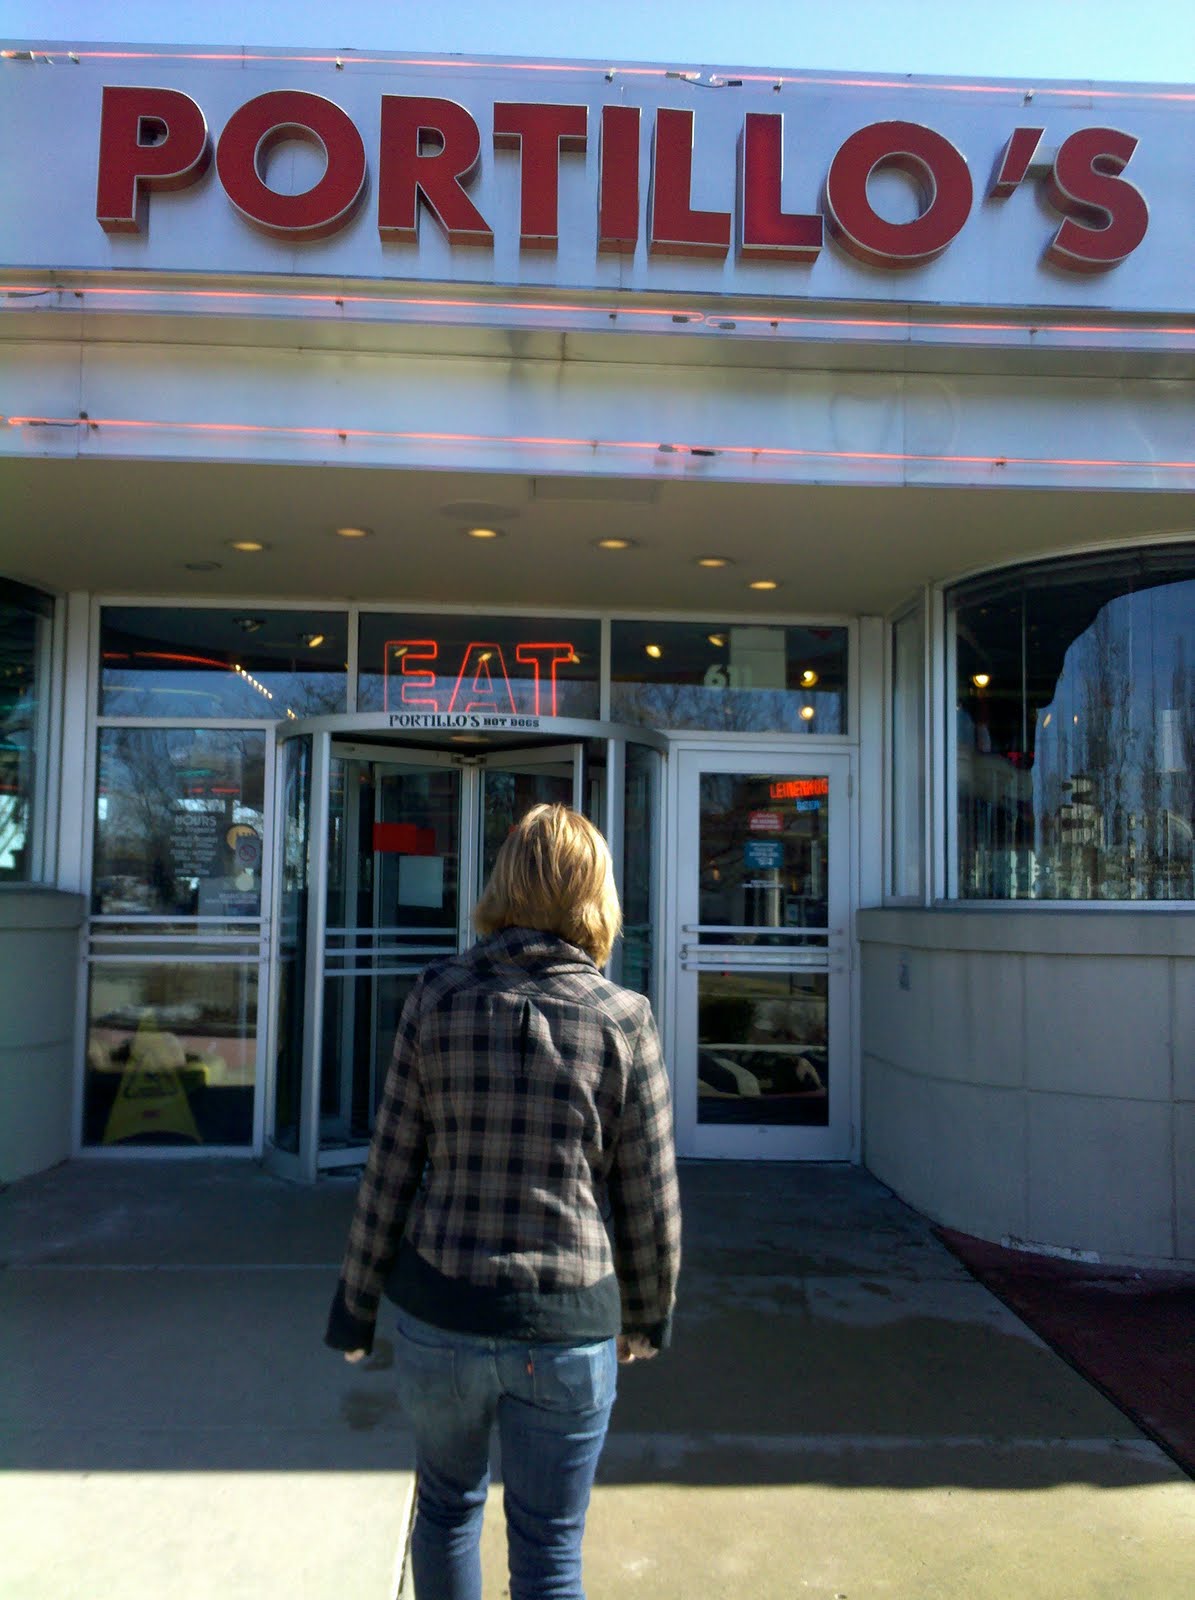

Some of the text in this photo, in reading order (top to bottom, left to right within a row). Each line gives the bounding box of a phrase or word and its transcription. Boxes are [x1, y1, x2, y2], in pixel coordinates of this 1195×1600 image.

[97, 85, 1150, 274] PORTILLO'S
[384, 639, 574, 717] EAT
[389, 713, 540, 729] PORTILLO'S HOT DOGS
